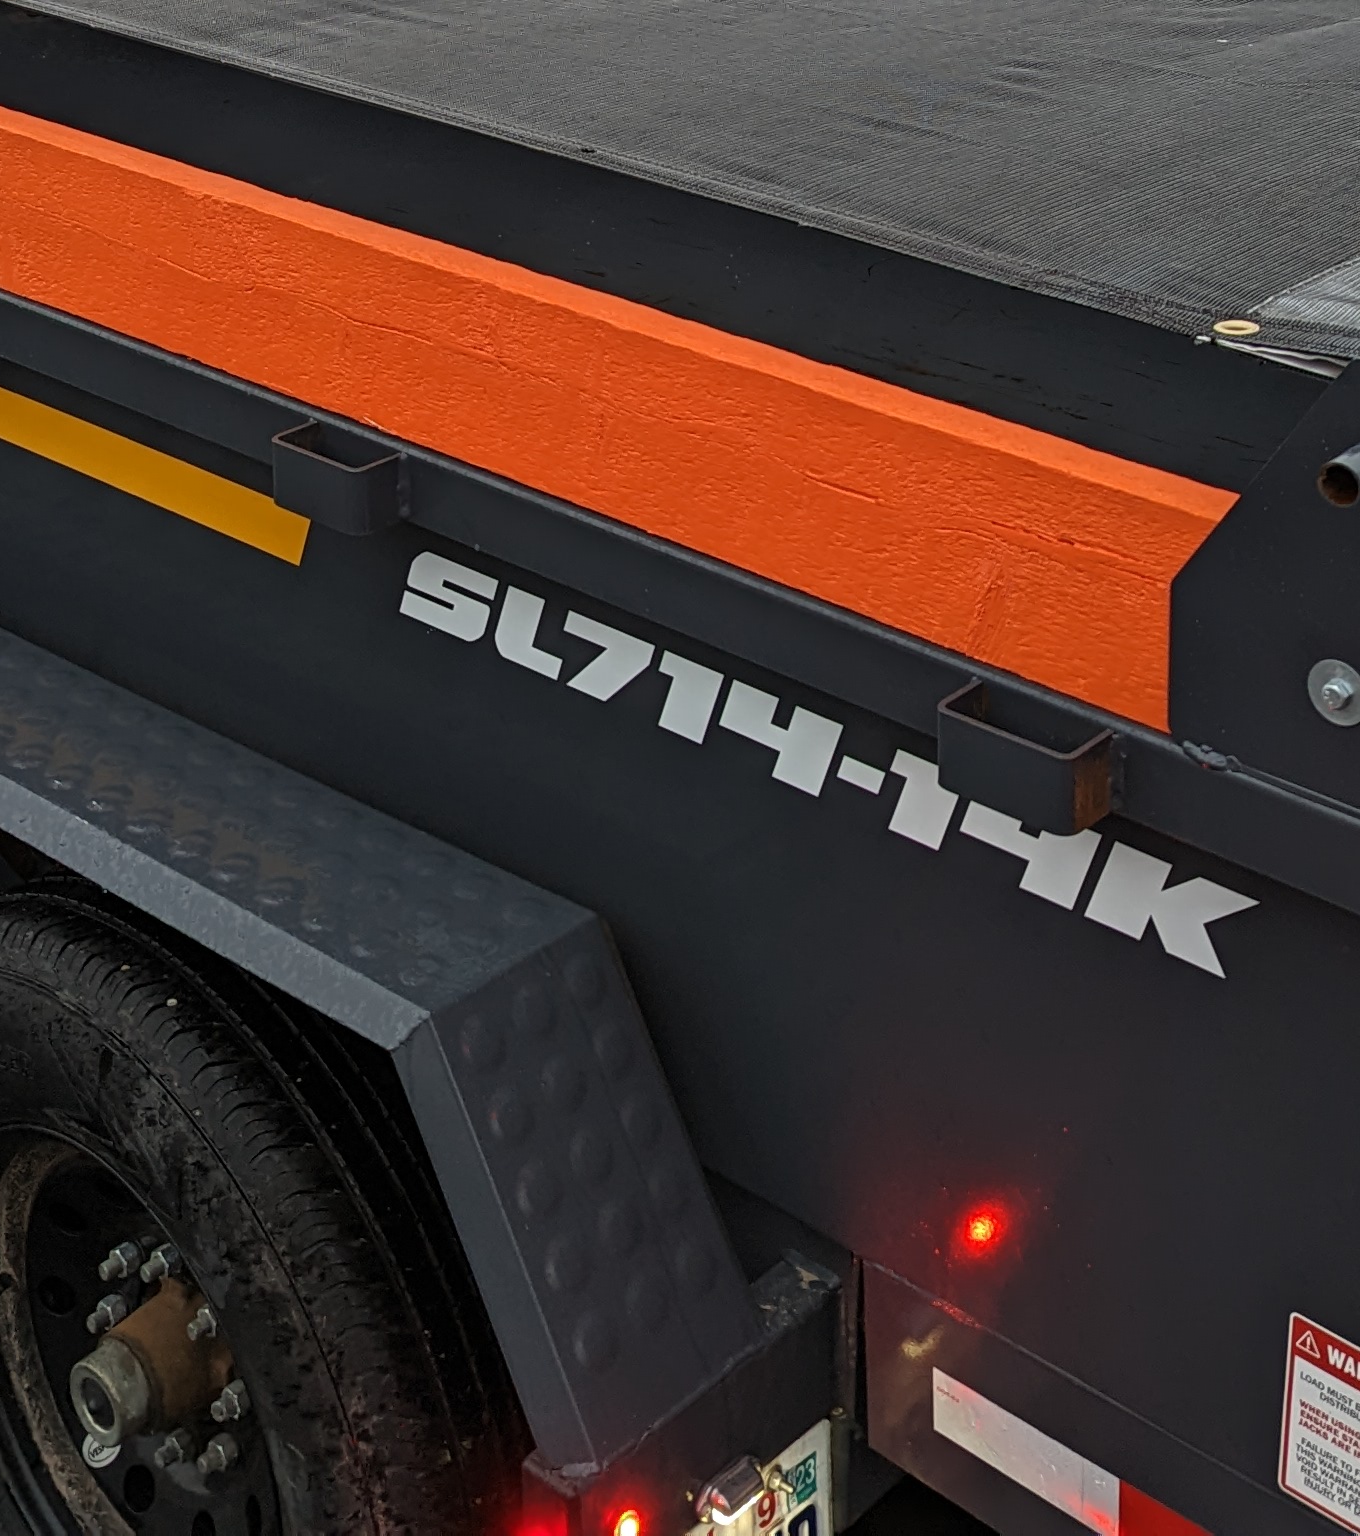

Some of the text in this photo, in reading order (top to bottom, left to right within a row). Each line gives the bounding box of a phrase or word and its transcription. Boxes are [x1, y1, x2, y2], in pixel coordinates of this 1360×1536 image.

[399, 551, 1261, 978] SL714-14K
[1300, 1371, 1325, 1391] LOAD
[1326, 1386, 1353, 1406] MUST
[1299, 1398, 1329, 1421] WHEN
[1300, 1409, 1340, 1436] ENSURE
[1296, 1443, 1316, 1461] THIS
[1298, 1418, 1329, 1441] JACKS
[1331, 1436, 1351, 1453] ARE
[1296, 1452, 1318, 1471] VOID
[1301, 1437, 1338, 1463] FAILURE
[1341, 1460, 1353, 1473] TO
[796, 1458, 815, 1491] 23
[1300, 1464, 1335, 1490] RESULT
[1336, 1486, 1347, 1498] IN
[1303, 1476, 1336, 1502] INJURY
[1337, 1496, 1351, 1511] OR
